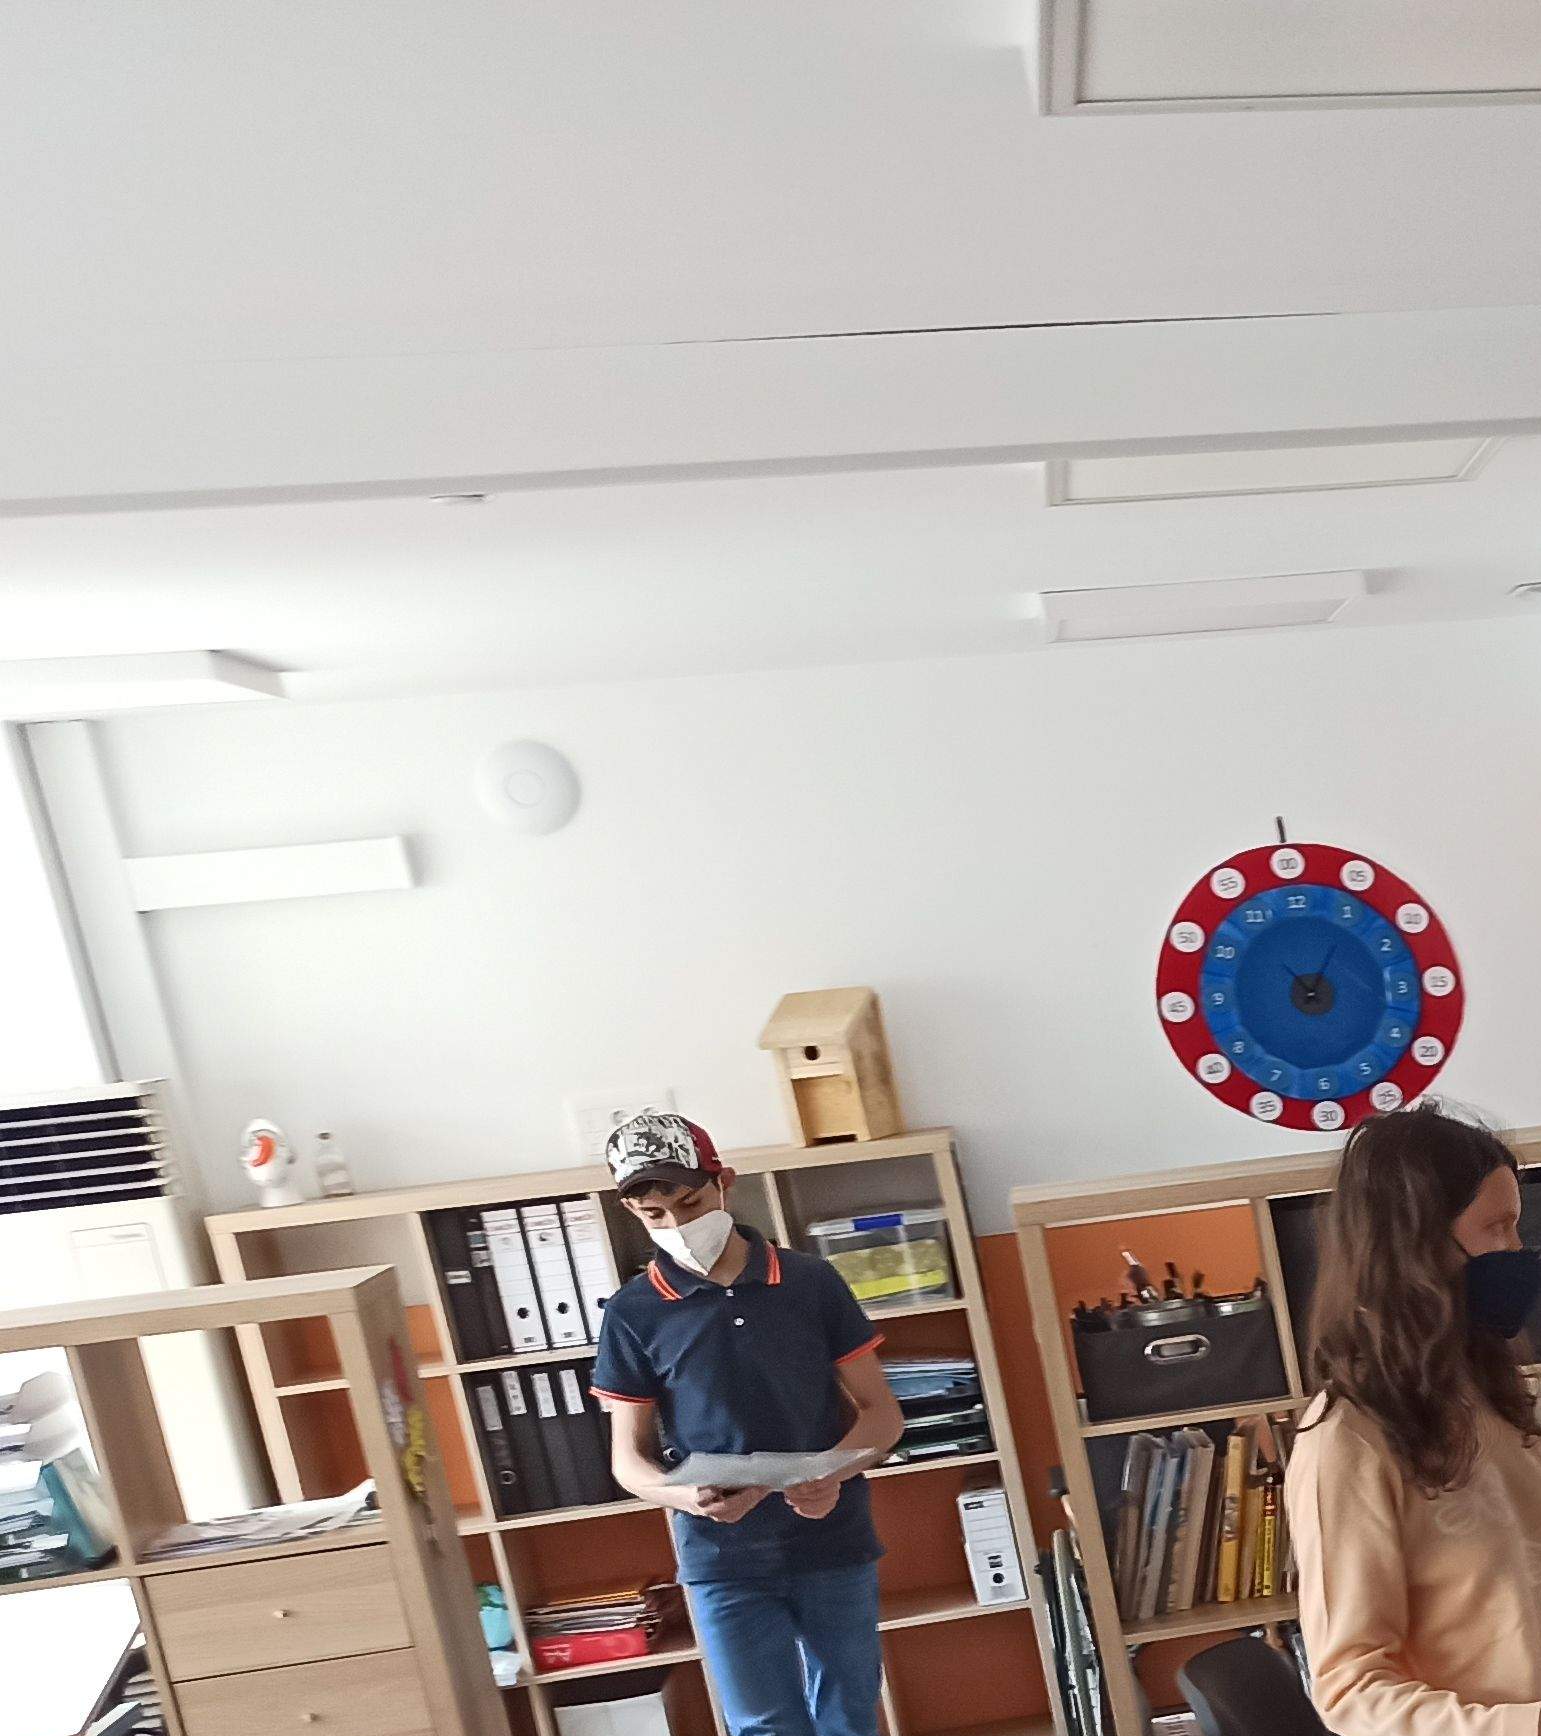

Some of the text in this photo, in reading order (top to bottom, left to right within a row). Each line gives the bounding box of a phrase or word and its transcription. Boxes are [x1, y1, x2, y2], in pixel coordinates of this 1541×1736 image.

[1287, 895, 1307, 909] 12
[1244, 909, 1265, 923] 11
[1341, 905, 1354, 919] 1
[1380, 938, 1392, 952] 2
[1215, 945, 1236, 960] 10
[1396, 980, 1409, 994] 3
[1211, 992, 1225, 1006] 9
[1389, 1026, 1403, 1039] 4
[1269, 1068, 1283, 1082] 7
[1358, 1062, 1372, 1075] 5
[1318, 1077, 1331, 1091] 6
[1319, 1110, 1338, 1123] 30
